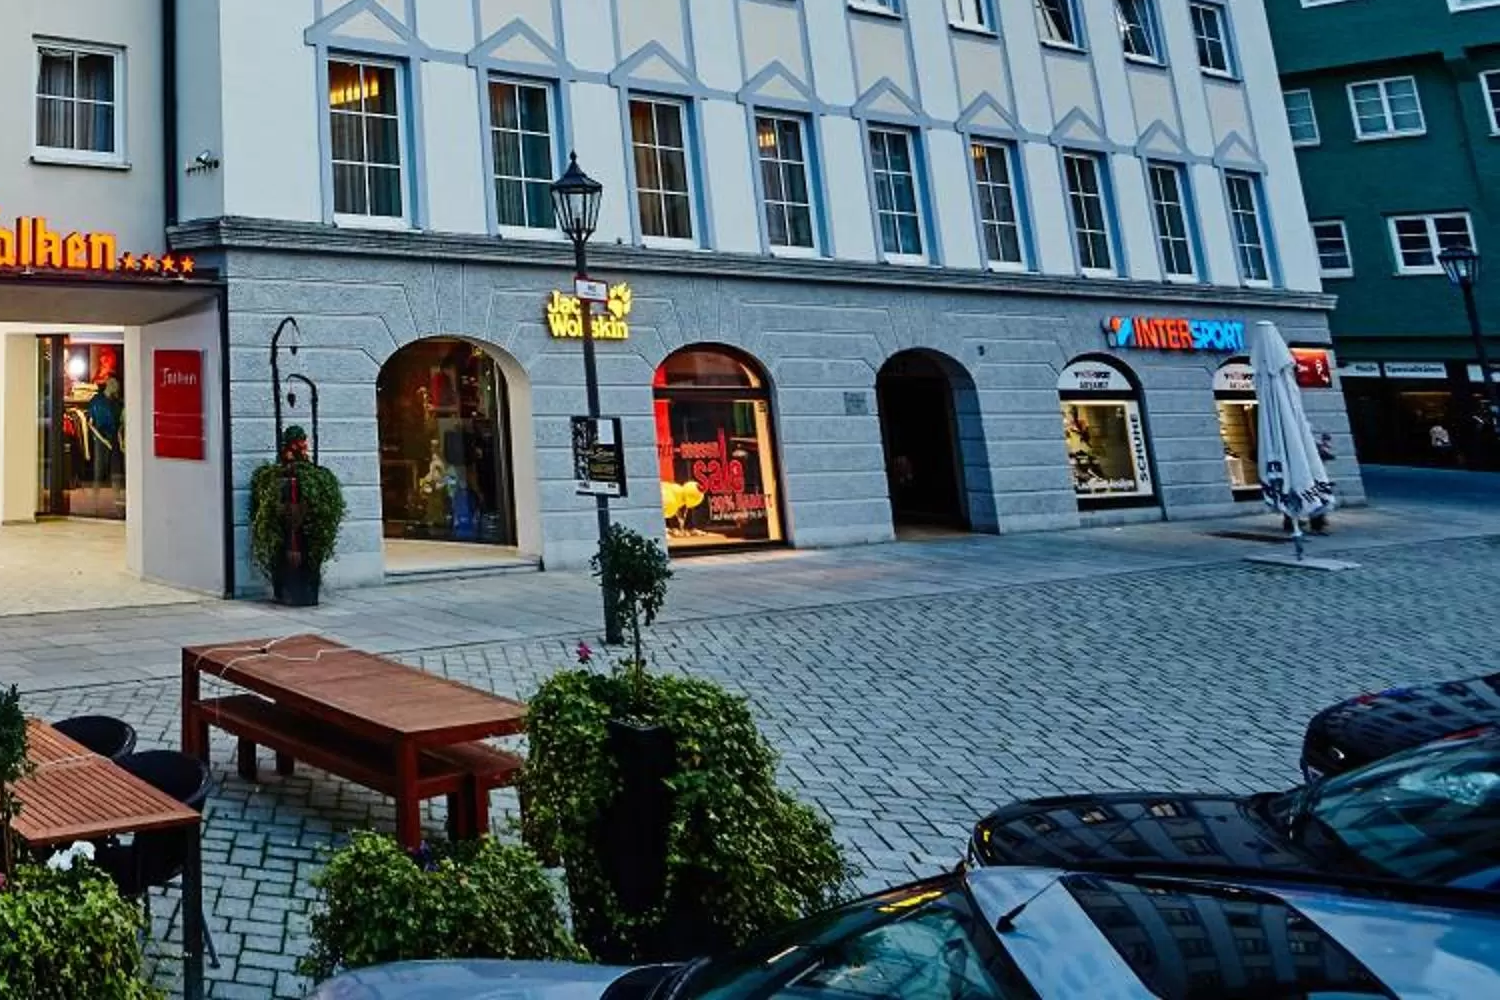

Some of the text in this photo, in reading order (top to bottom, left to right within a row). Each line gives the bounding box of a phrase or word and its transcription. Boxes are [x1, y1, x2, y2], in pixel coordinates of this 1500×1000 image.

[547, 289, 582, 314] Jac
[547, 312, 629, 339] Wolskin
[1133, 316, 1245, 350] INTERSPORT
[1129, 412, 1149, 483] SCHUHE
